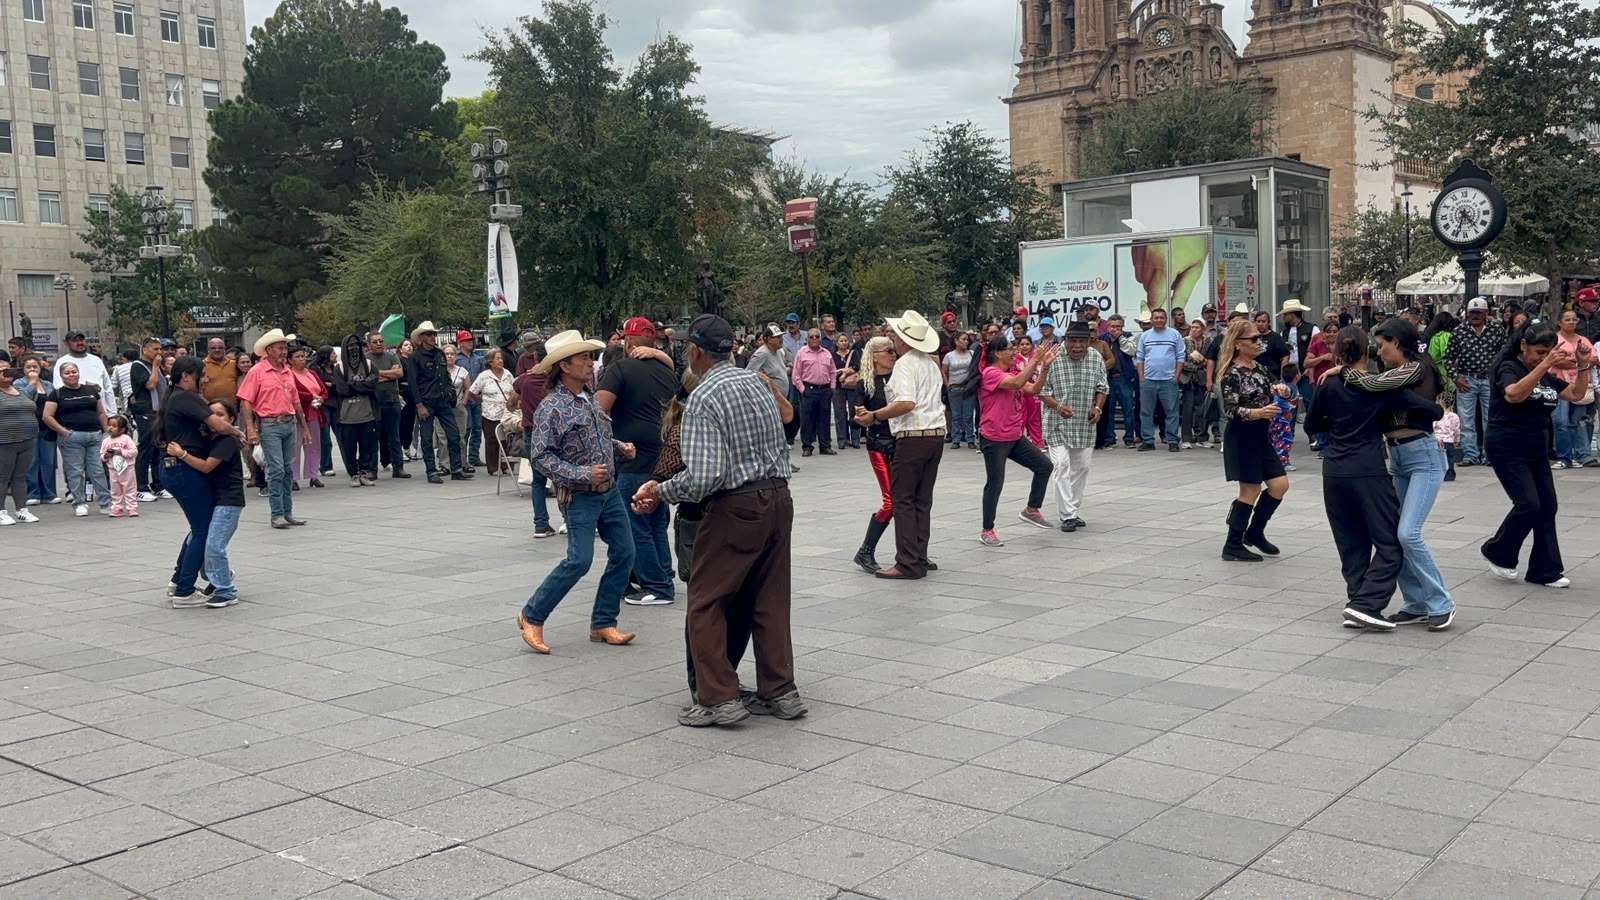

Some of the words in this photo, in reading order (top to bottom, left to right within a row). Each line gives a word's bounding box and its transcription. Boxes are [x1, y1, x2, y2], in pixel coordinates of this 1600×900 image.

[1067, 283, 1094, 292] MUJERES
[1028, 296, 1112, 315] LACTAO
[1030, 314, 1073, 328] MVI
